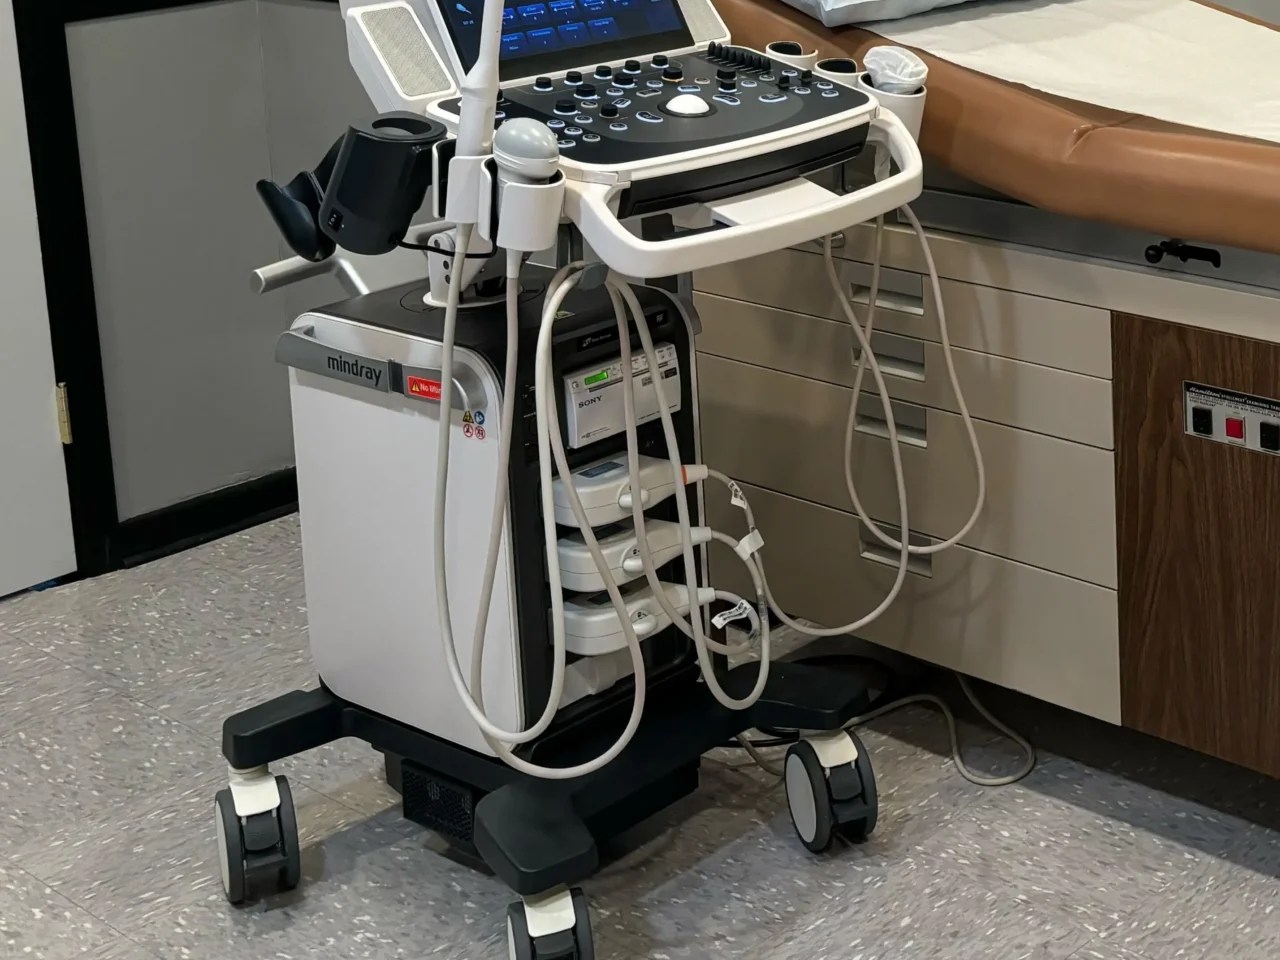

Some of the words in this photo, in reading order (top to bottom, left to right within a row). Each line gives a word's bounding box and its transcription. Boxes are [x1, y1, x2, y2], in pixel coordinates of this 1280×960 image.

[327, 355, 382, 387] mindray
[420, 383, 429, 392] No
[1189, 386, 1220, 398] Hamilton
[578, 395, 602, 408] SONY
